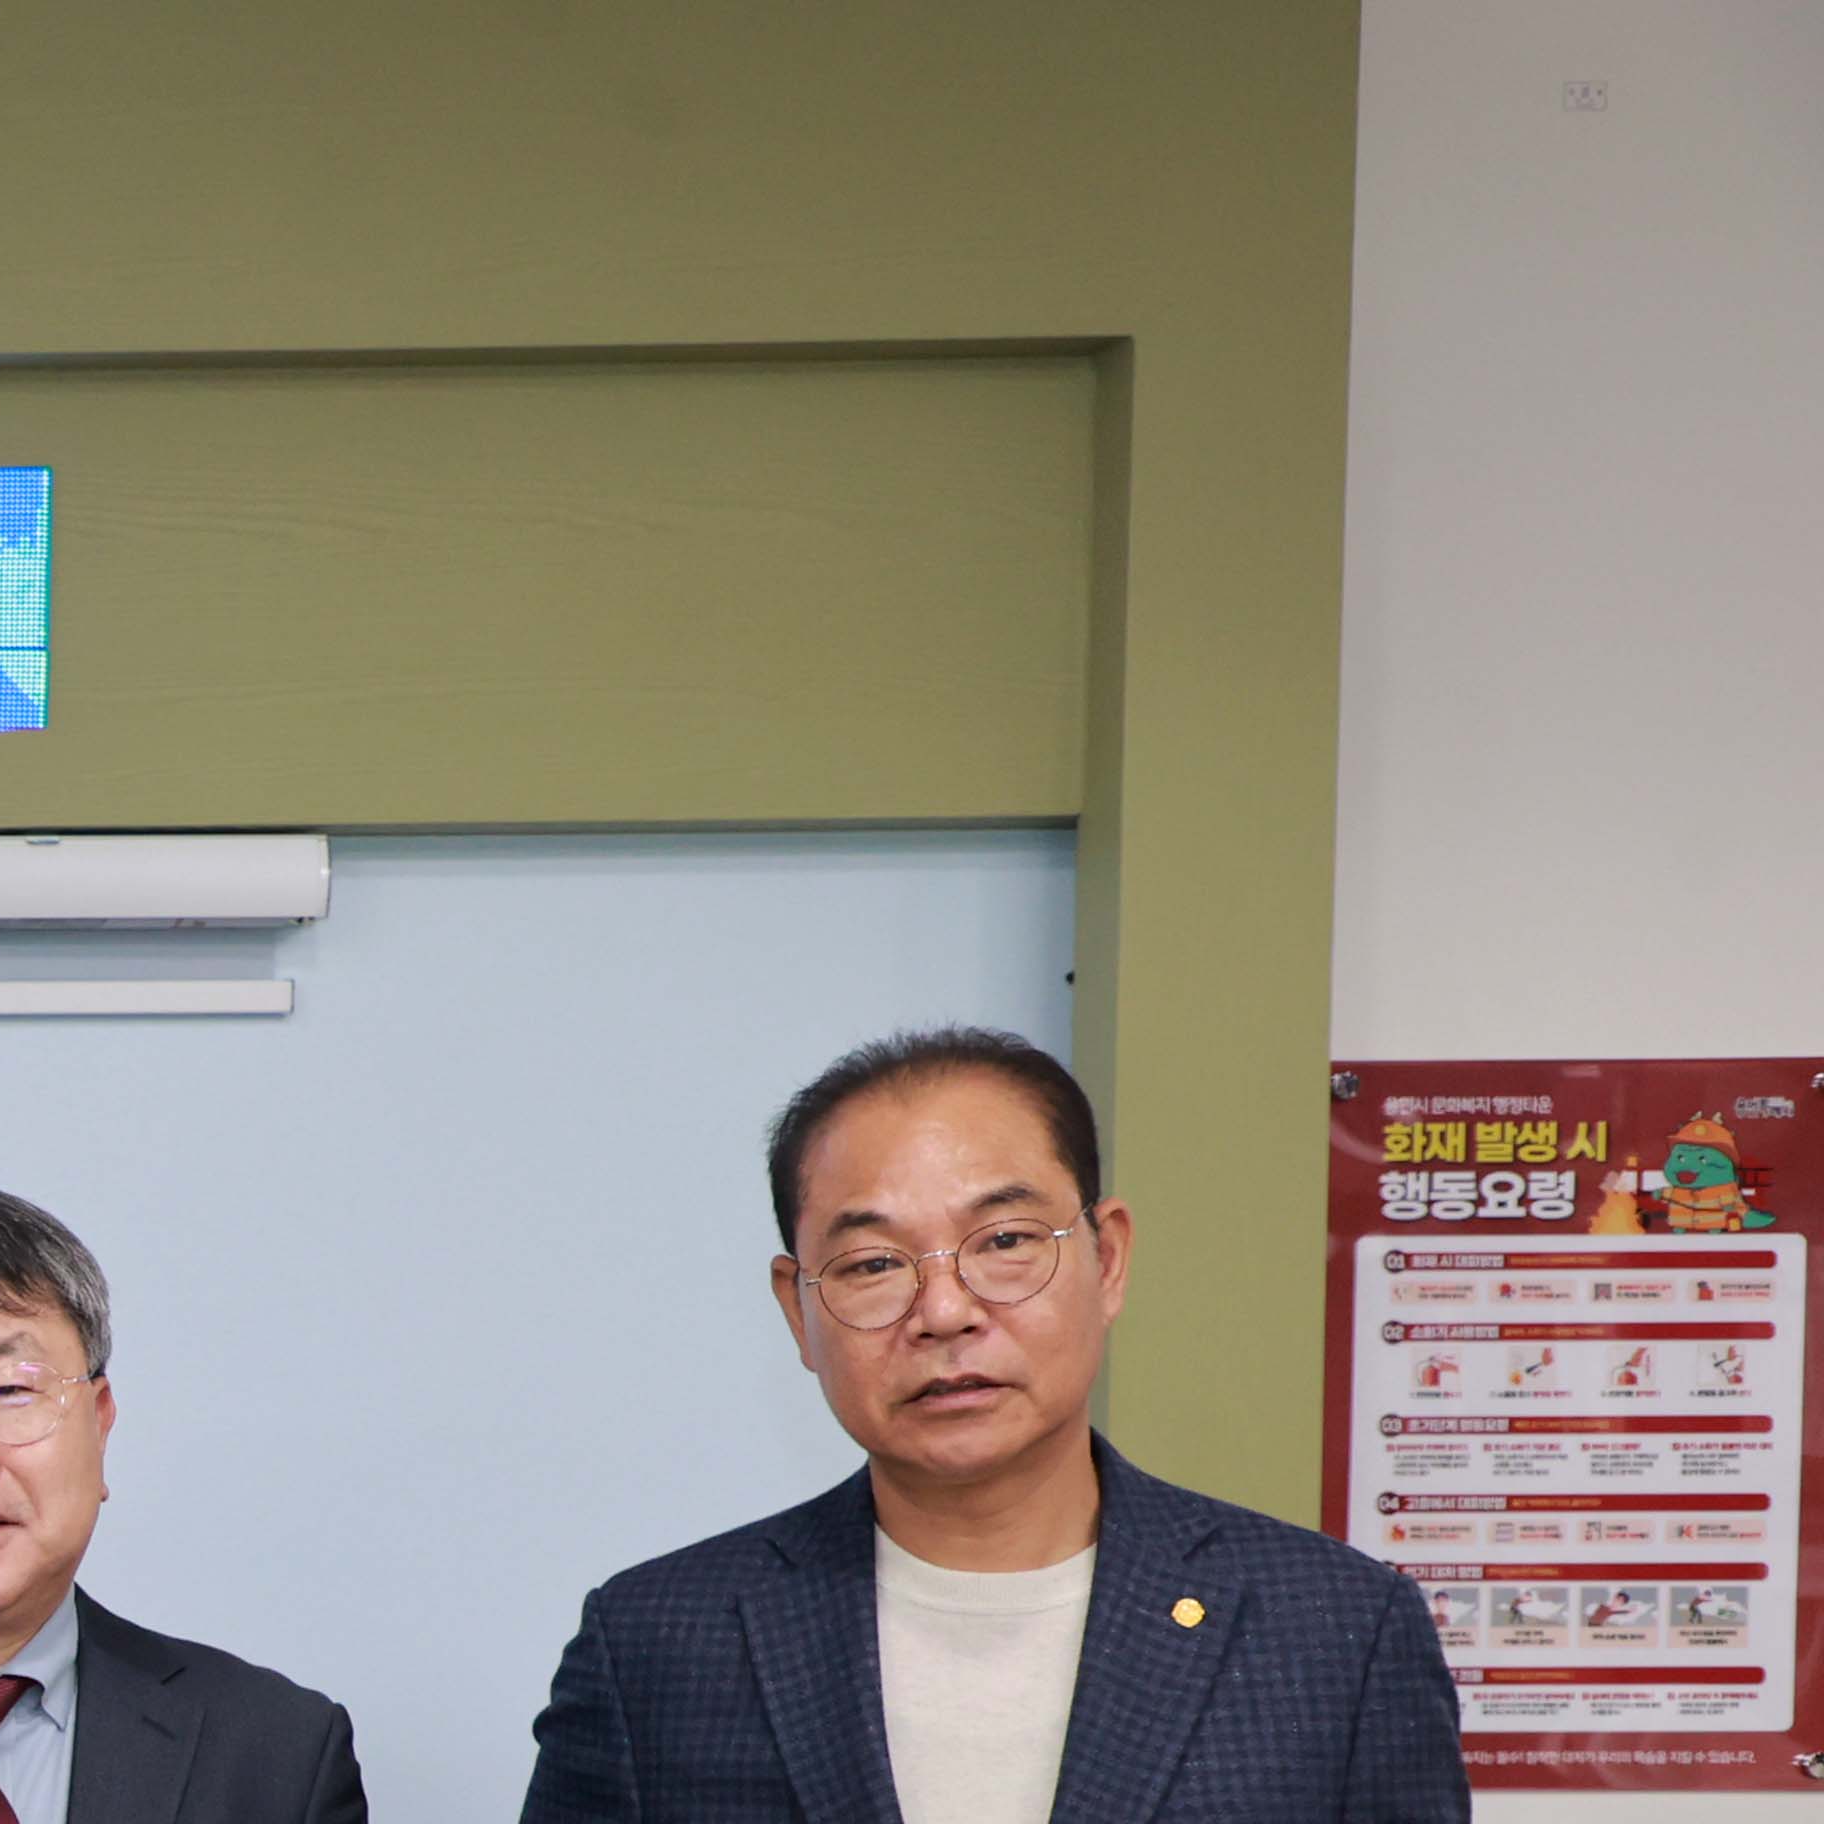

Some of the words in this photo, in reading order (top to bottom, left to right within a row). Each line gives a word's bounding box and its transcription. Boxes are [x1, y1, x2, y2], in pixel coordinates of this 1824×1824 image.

[1382, 1121, 1466, 1163] 화재
[1476, 1121, 1558, 1163] 발생
[1566, 1120, 1608, 1162] 시
[1378, 1170, 1576, 1221] 행동요령
